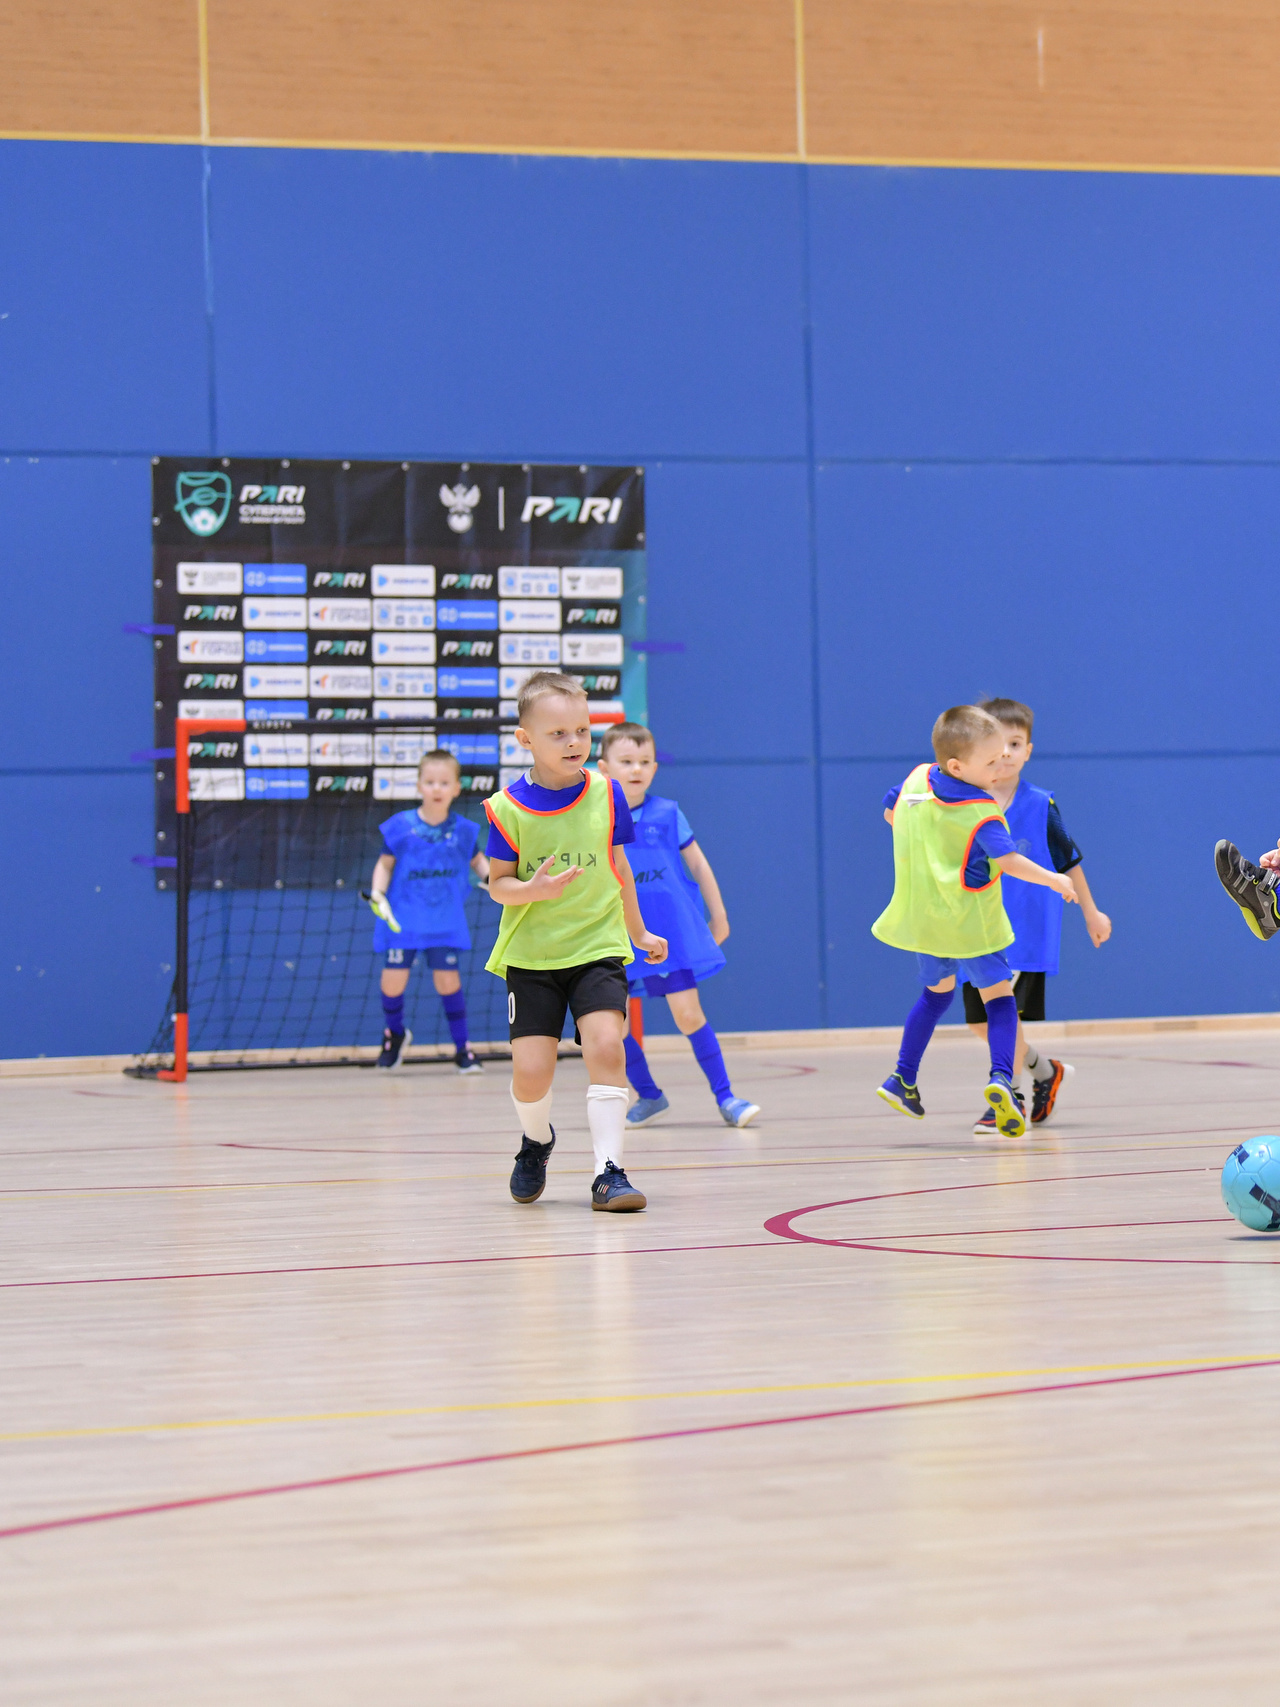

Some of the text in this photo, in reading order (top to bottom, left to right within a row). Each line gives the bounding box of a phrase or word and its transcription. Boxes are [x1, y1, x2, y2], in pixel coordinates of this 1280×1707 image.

[239, 485, 306, 503] PARI
[520, 496, 623, 524] PARI
[312, 572, 366, 588] PARI
[441, 573, 493, 589] PARI
[184, 605, 238, 621] PARI
[566, 608, 618, 624] PARI
[314, 640, 368, 656] PARI
[442, 641, 494, 657] PARI
[184, 673, 238, 689] PARI
[315, 776, 368, 792] PARI
